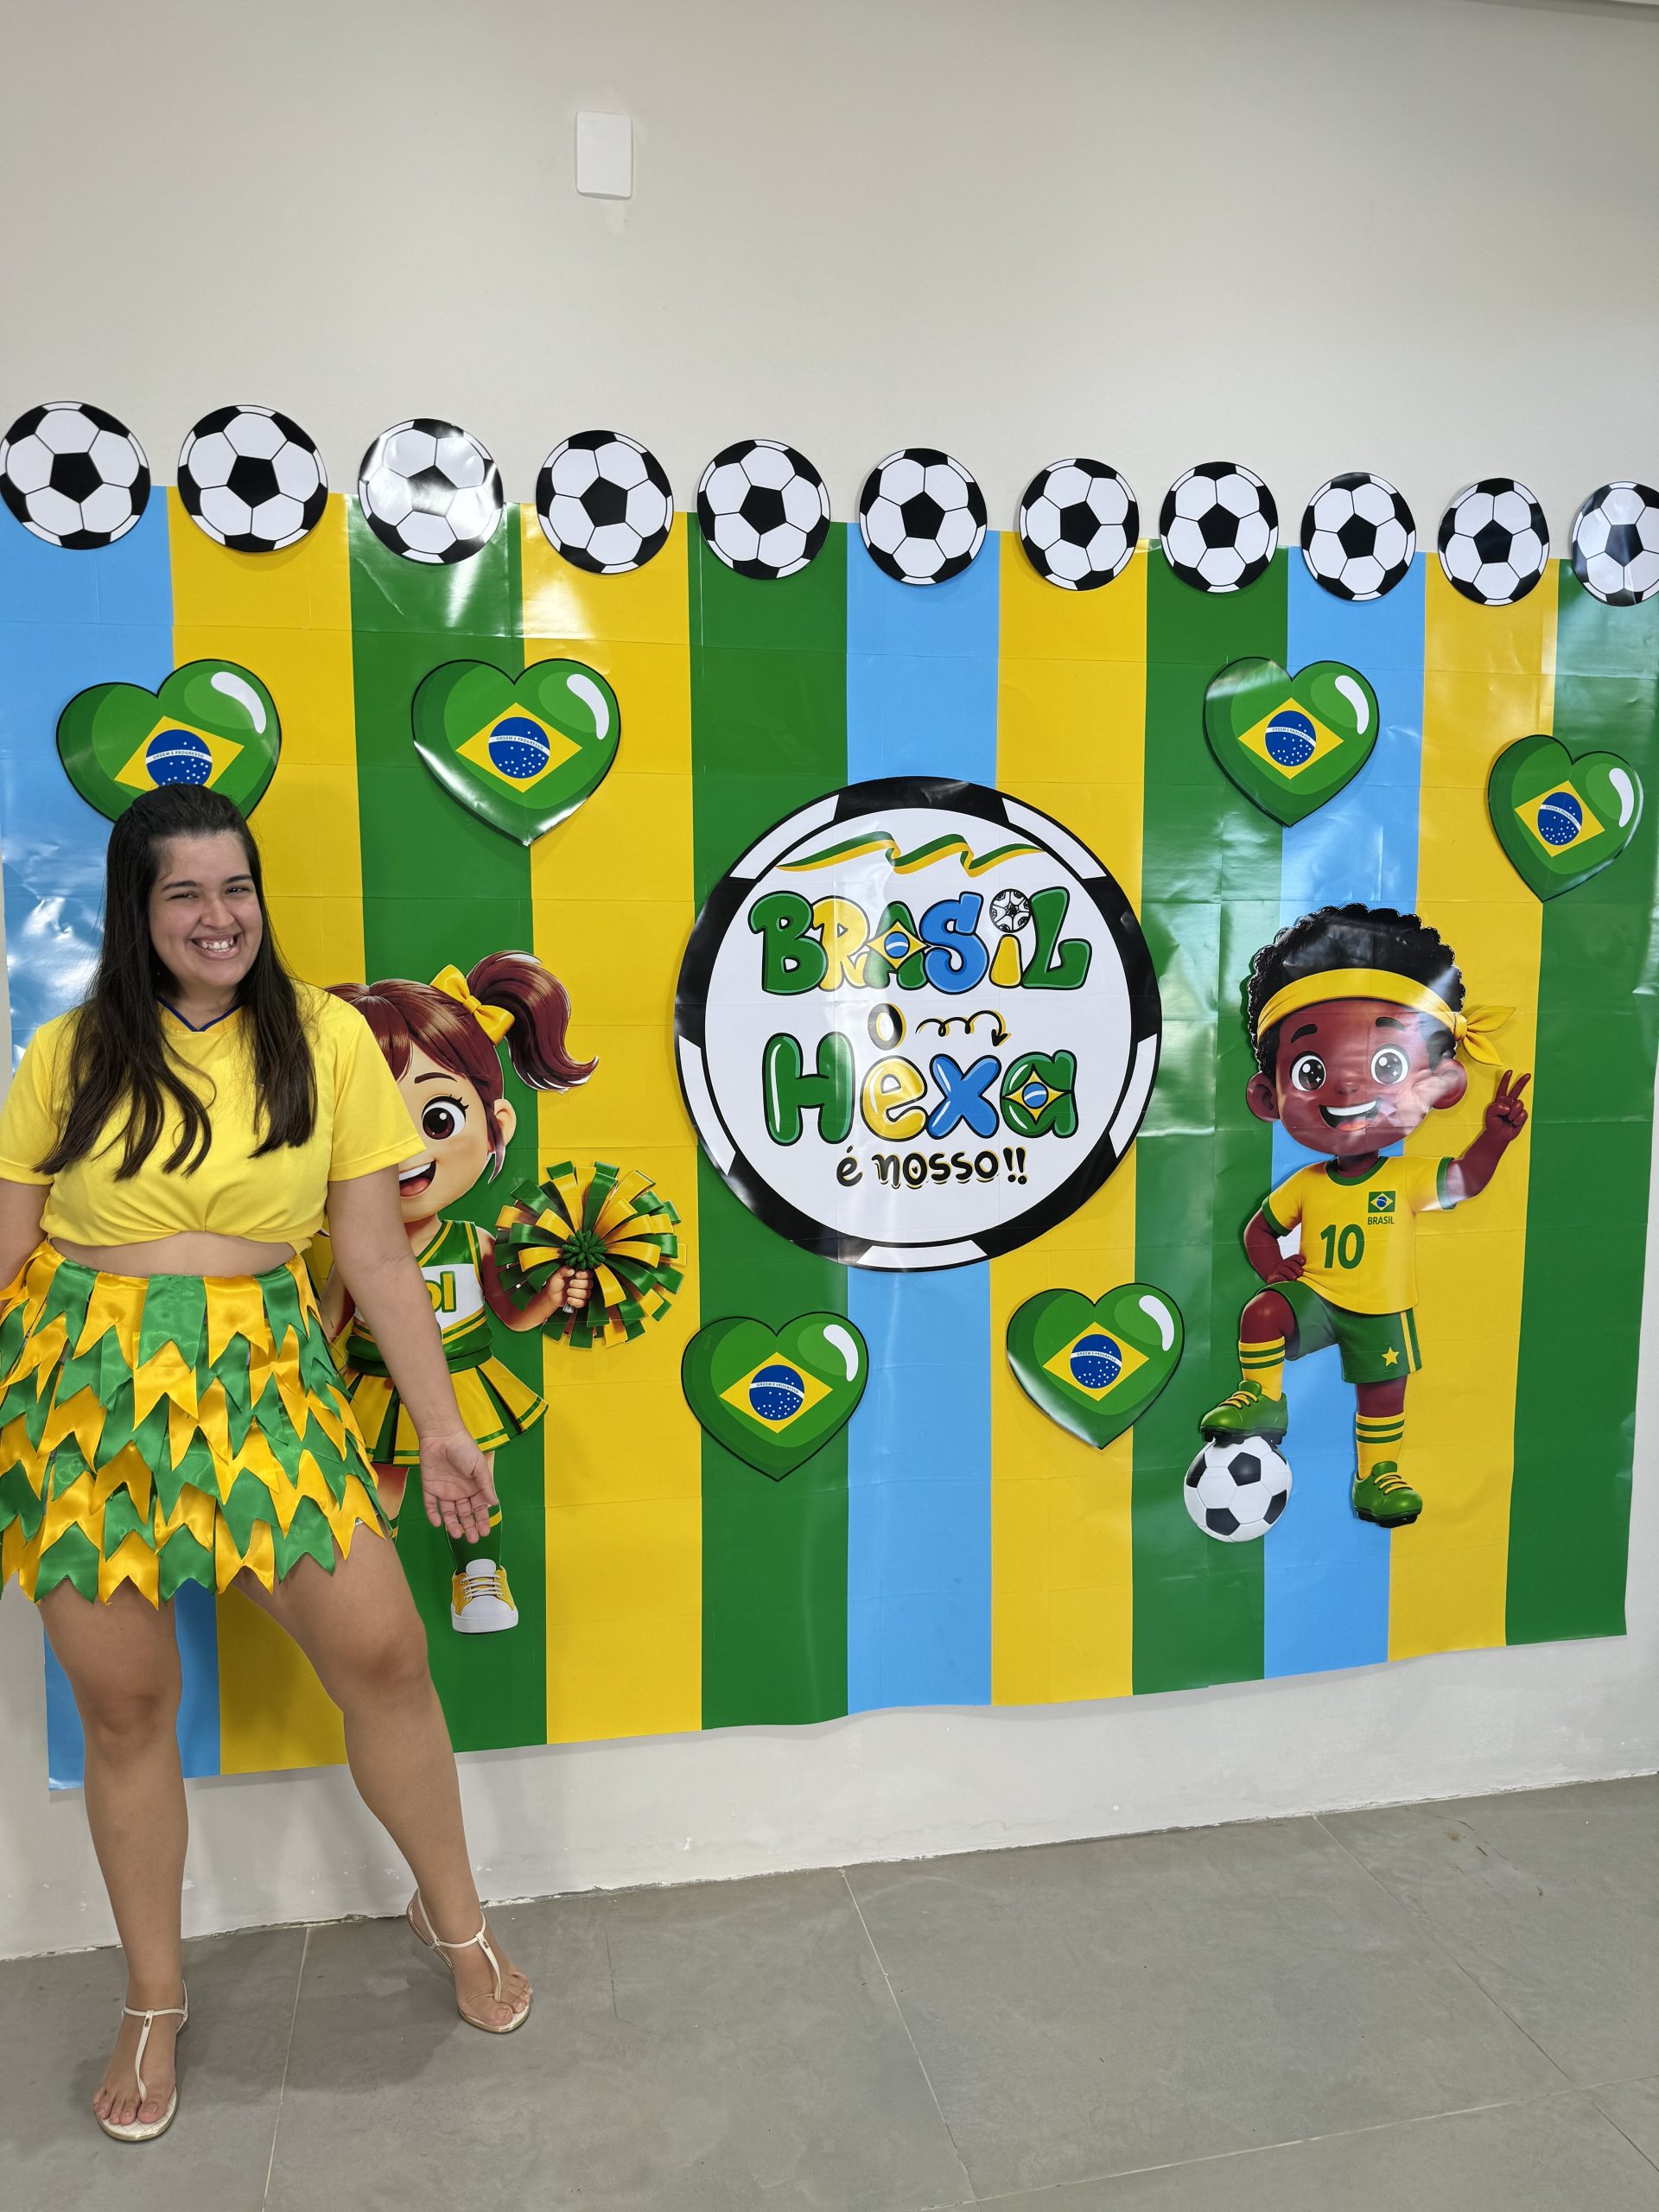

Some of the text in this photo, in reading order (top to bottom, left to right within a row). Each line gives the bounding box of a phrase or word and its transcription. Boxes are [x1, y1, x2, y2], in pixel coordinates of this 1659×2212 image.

[761, 1032, 1079, 1146] Hexa
[836, 1145, 1028, 1190] é nosso!!
[1367, 1216, 1395, 1225] BRASIL
[1320, 1224, 1365, 1269] 10
